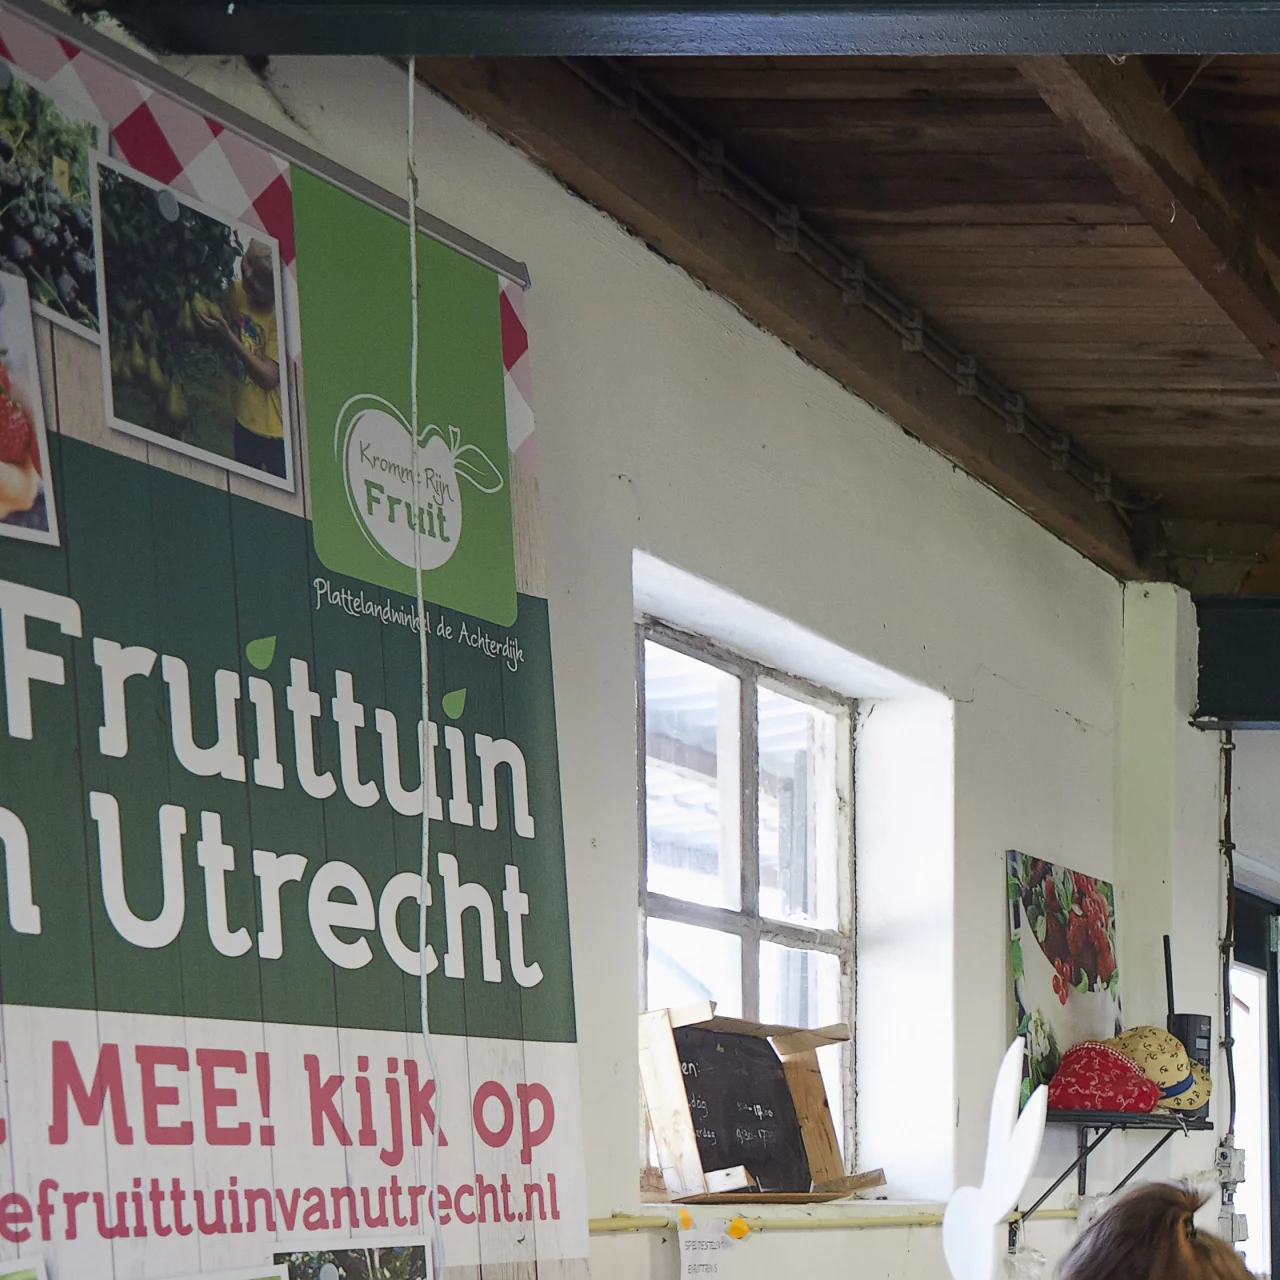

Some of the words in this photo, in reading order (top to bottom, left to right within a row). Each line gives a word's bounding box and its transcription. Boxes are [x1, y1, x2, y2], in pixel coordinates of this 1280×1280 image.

[363, 478, 451, 544] Fruit
[424, 467, 455, 506] Rijn
[436, 615, 453, 640] de
[457, 621, 525, 673] Achterdijk
[0, 579, 536, 840] Fruittuin
[89, 790, 544, 988] Utrecht
[48, 1039, 277, 1147] MEE!
[304, 1052, 449, 1167] kijk
[472, 1078, 556, 1166] op
[0, 1174, 561, 1242] efruittuinvanutrecht.nl
